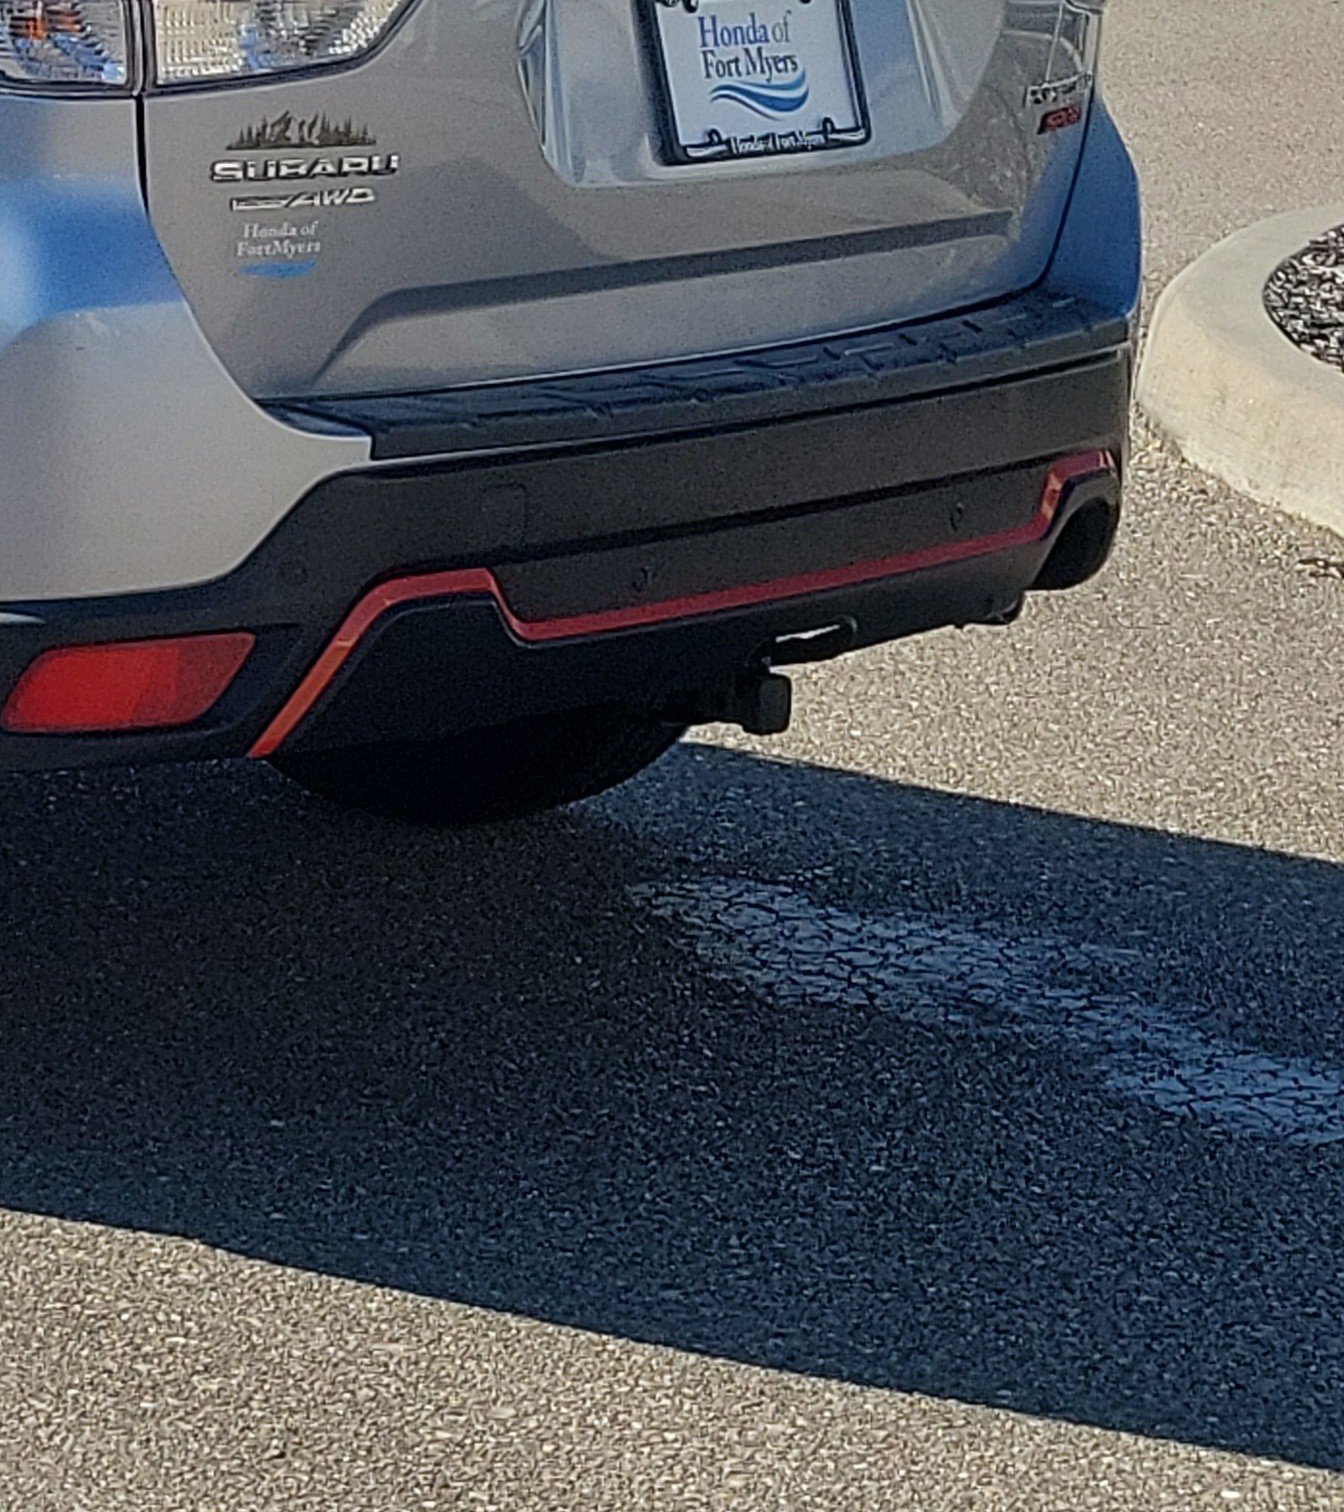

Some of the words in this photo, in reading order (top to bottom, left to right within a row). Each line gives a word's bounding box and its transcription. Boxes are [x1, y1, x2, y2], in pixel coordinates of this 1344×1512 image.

[697, 13, 769, 48] Honda
[772, 11, 791, 44] of
[702, 49, 742, 79] Fort
[745, 45, 799, 83] Myers
[210, 152, 400, 183] SUBARU
[286, 186, 376, 208] AWD
[243, 221, 297, 238] Honda
[300, 220, 319, 236] of
